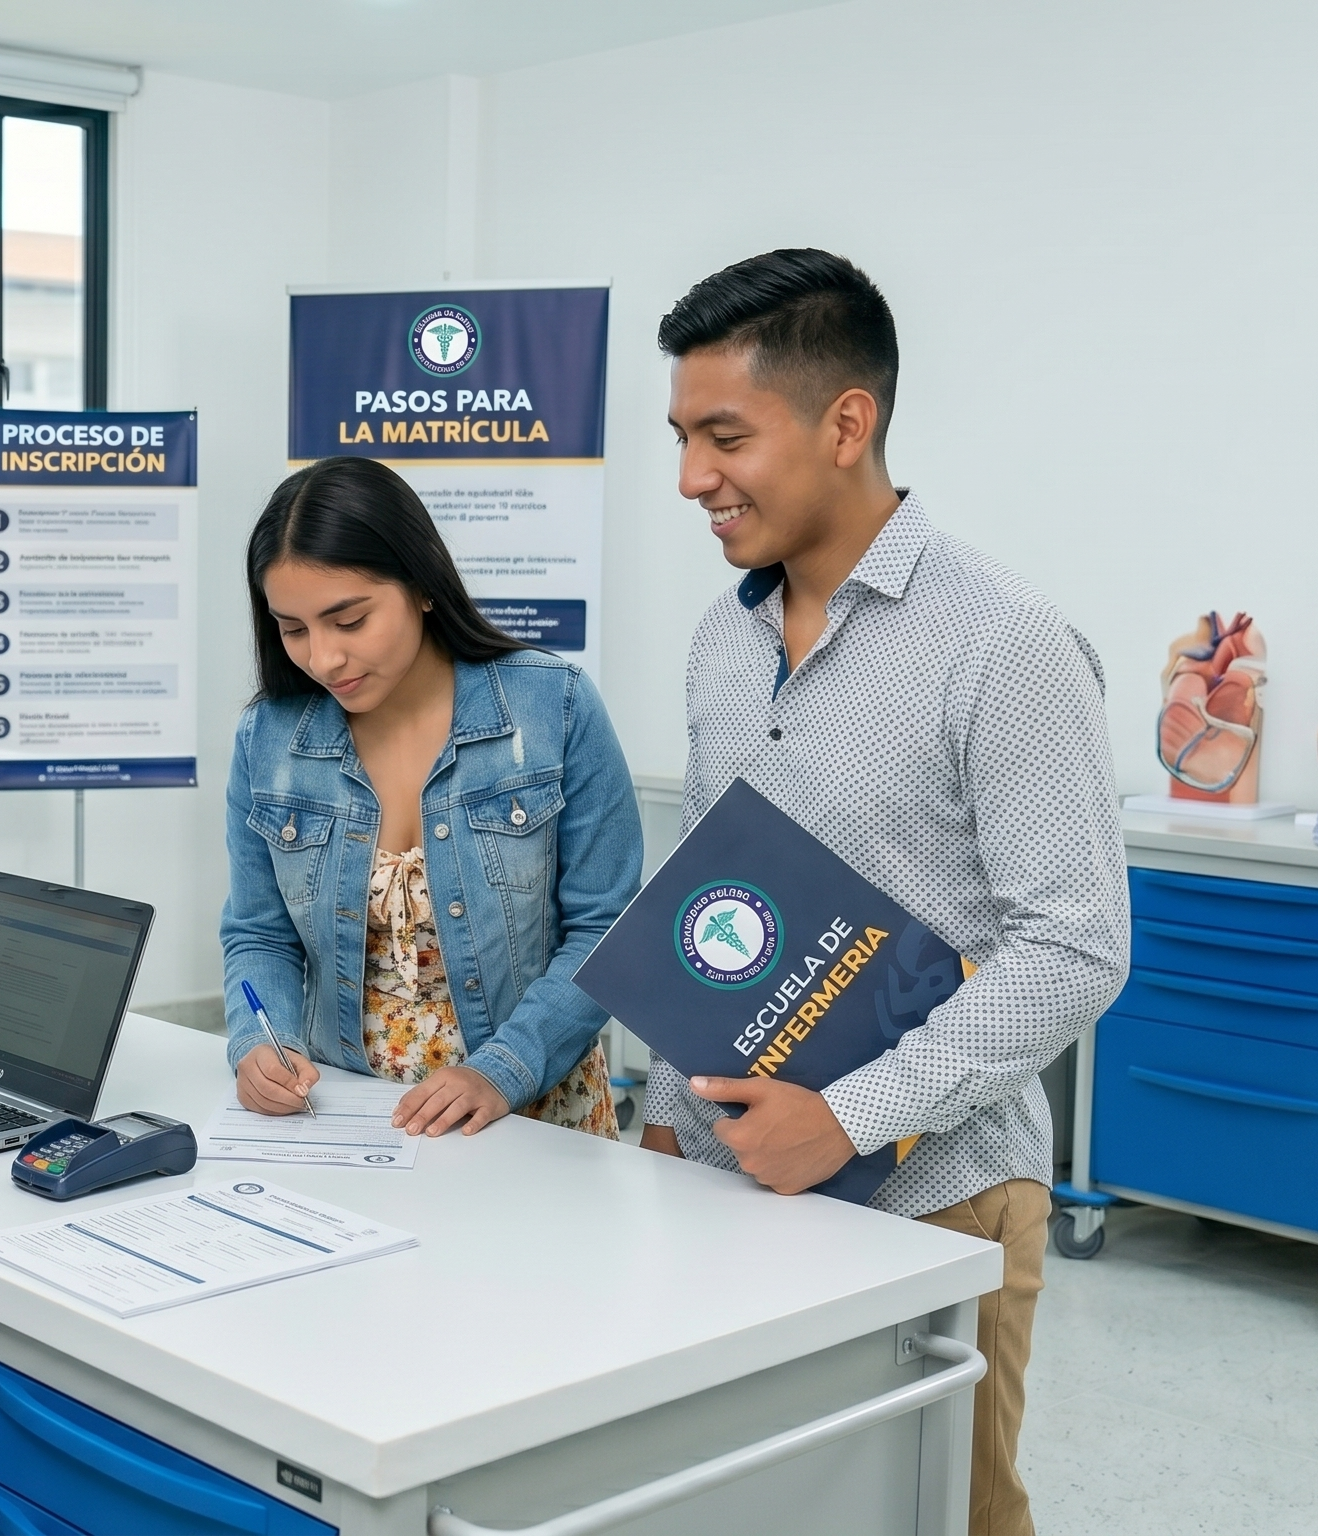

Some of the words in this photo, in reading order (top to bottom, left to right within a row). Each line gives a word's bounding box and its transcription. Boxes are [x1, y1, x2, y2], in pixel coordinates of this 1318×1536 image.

[355, 390, 448, 413] PASOS
[457, 389, 533, 412] PARA
[2, 424, 125, 447] PROCESO
[131, 425, 165, 447] DE
[339, 421, 374, 444] LA
[382, 416, 549, 444] MATRÍCULA
[1, 447, 165, 473] INSCRIPCIÓN
[732, 955, 826, 1057] ESCUELA
[817, 916, 853, 954] DE
